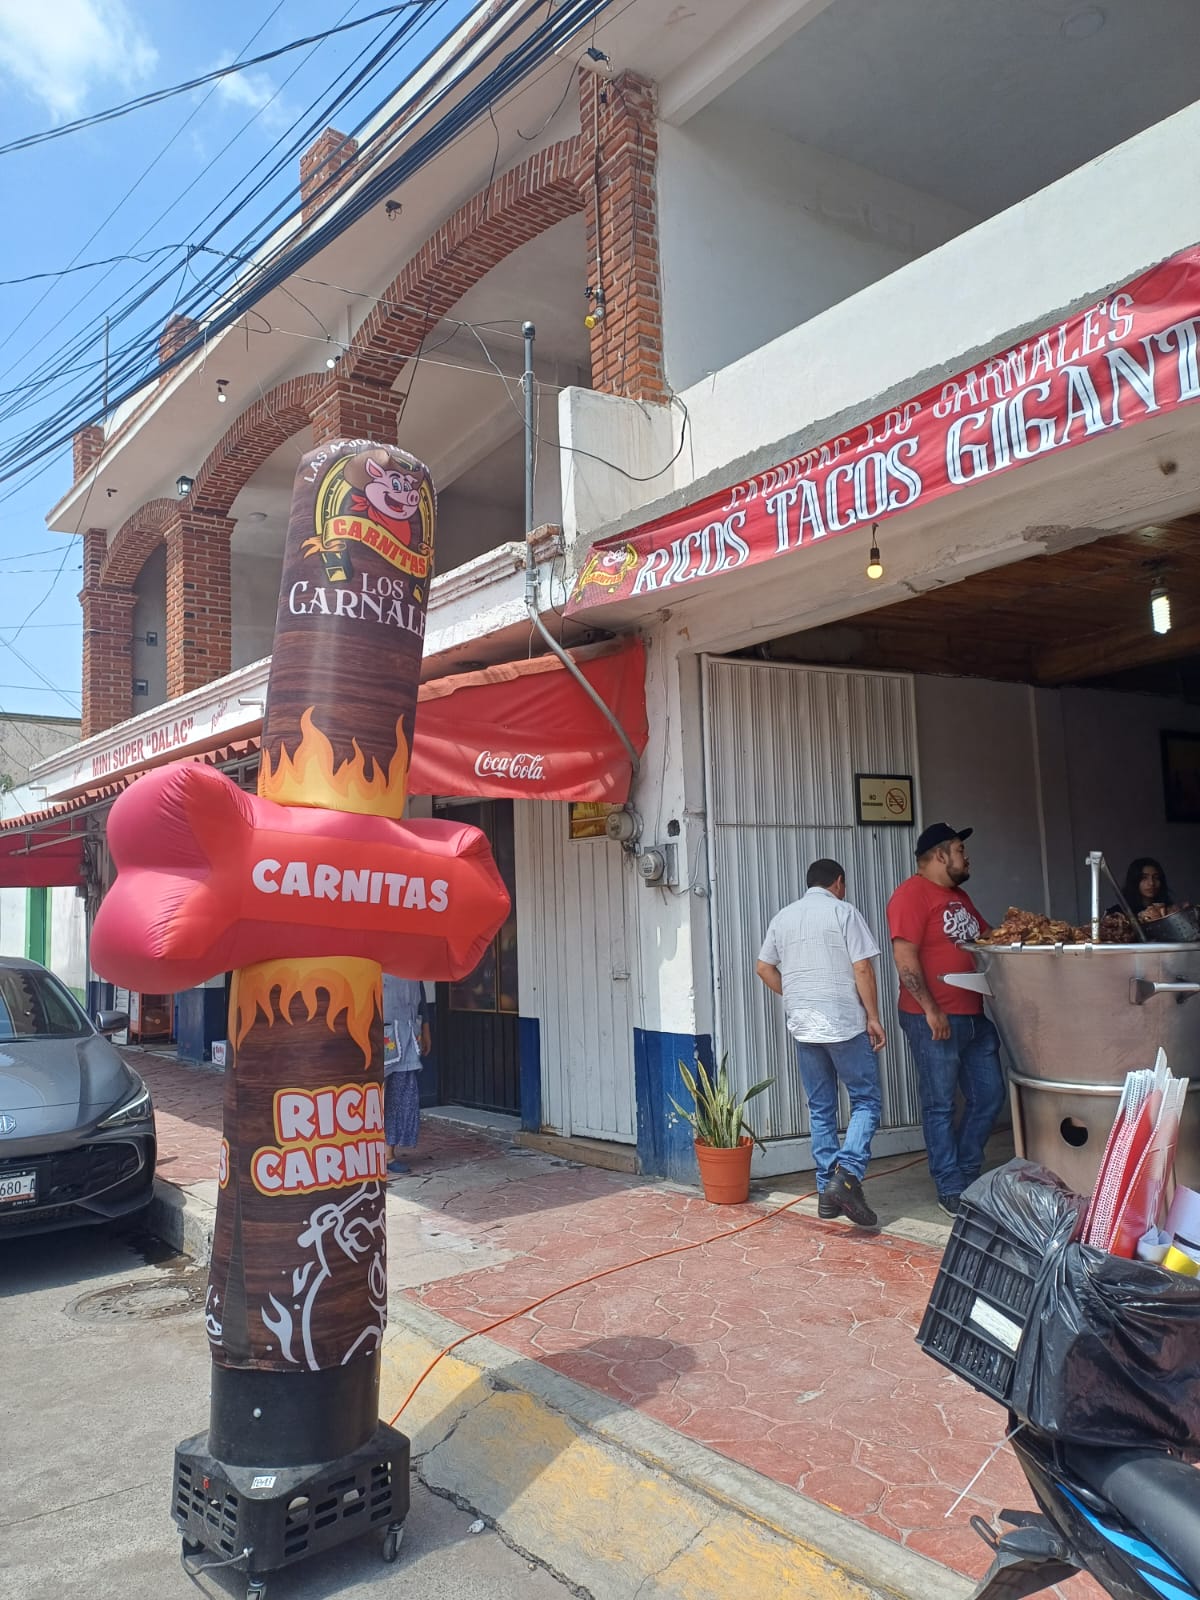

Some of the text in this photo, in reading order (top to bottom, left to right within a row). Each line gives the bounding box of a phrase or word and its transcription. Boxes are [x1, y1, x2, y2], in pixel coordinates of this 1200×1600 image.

[304, 451, 328, 482] LAS
[629, 510, 749, 596] RICOS
[766, 435, 922, 555] TACOS
[332, 519, 427, 576] CARNITAS
[361, 572, 404, 600] LOS
[92, 751, 111, 778] MINI
[113, 738, 145, 770] SUPER
[474, 750, 546, 780] Coca-Cola
[252, 858, 449, 913] CARNITAS
